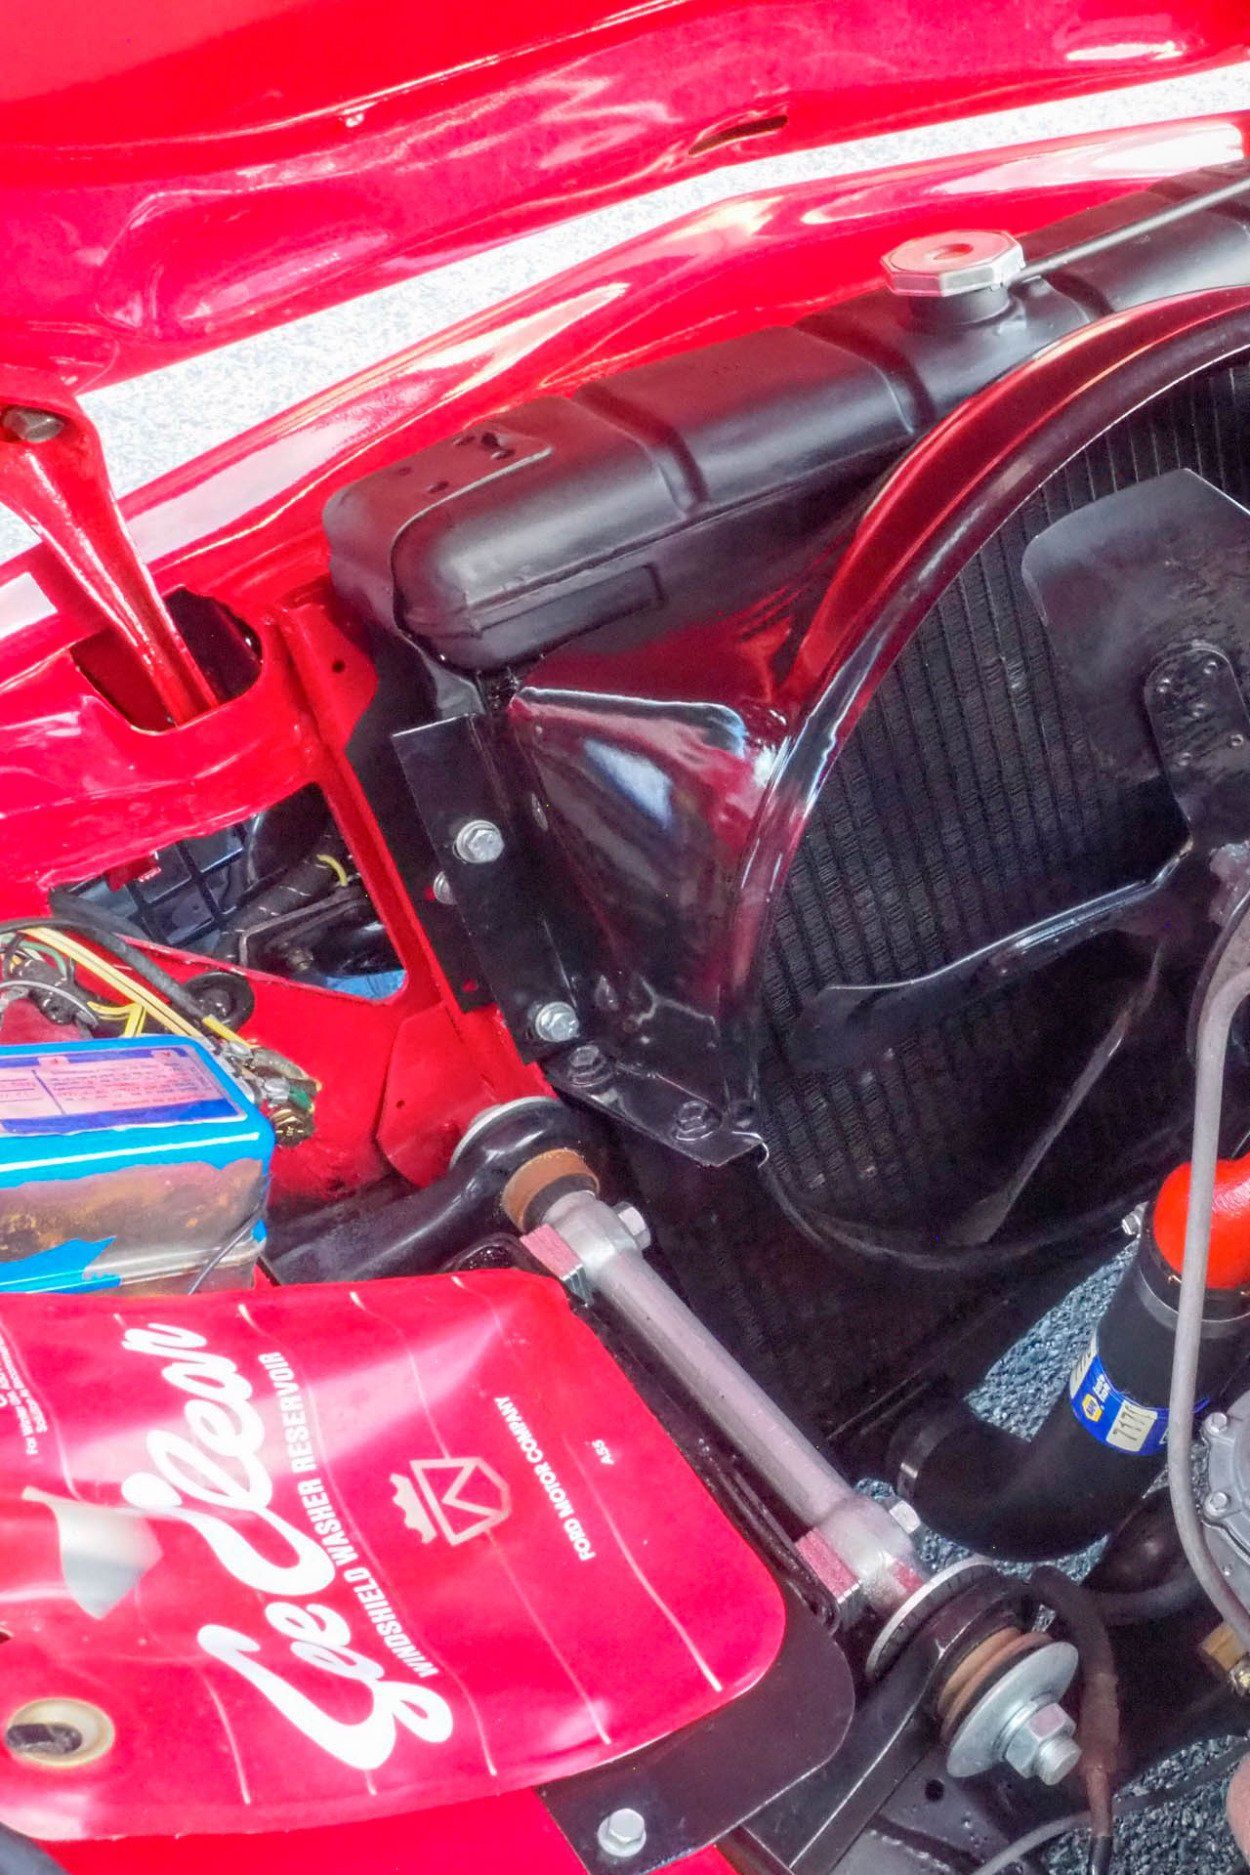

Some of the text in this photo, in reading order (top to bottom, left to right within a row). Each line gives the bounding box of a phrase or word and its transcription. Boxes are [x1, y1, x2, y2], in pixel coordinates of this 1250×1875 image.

[257, 1351, 440, 1678] WINDSHIELD WASHER RESERVOIR
[493, 1395, 596, 1562] FORD MOTOR COMPANY
[197, 1601, 453, 1770] See
